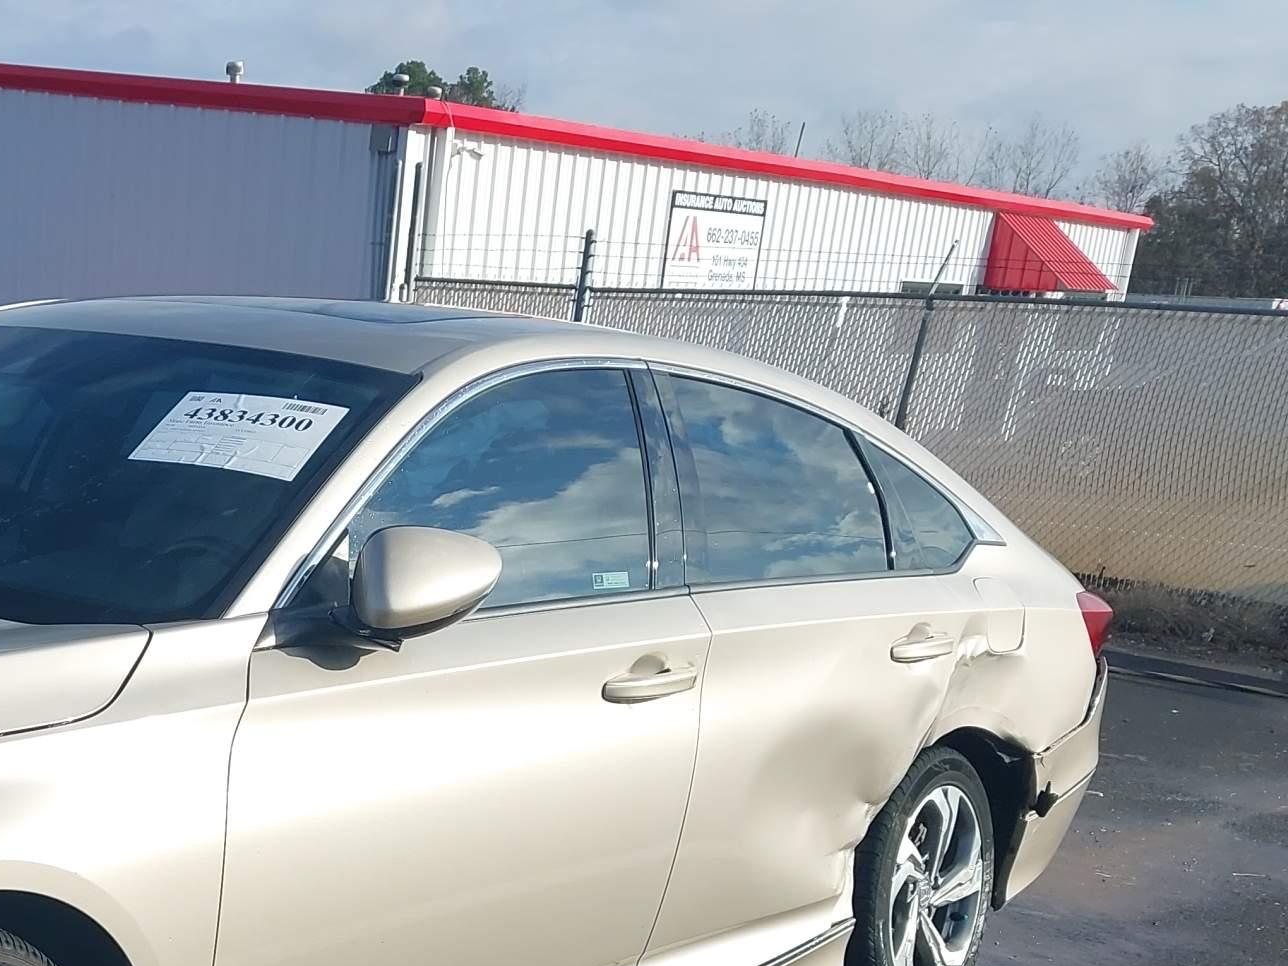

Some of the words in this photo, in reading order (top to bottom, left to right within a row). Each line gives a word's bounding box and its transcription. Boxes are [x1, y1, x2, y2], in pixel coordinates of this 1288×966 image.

[676, 193, 714, 210] INSURANCE
[714, 198, 732, 212] AUTO
[733, 200, 764, 214] AUCTIONS
[707, 227, 759, 246] 662-237-0455
[736, 271, 745, 282] MS
[184, 407, 312, 431] 43834300
